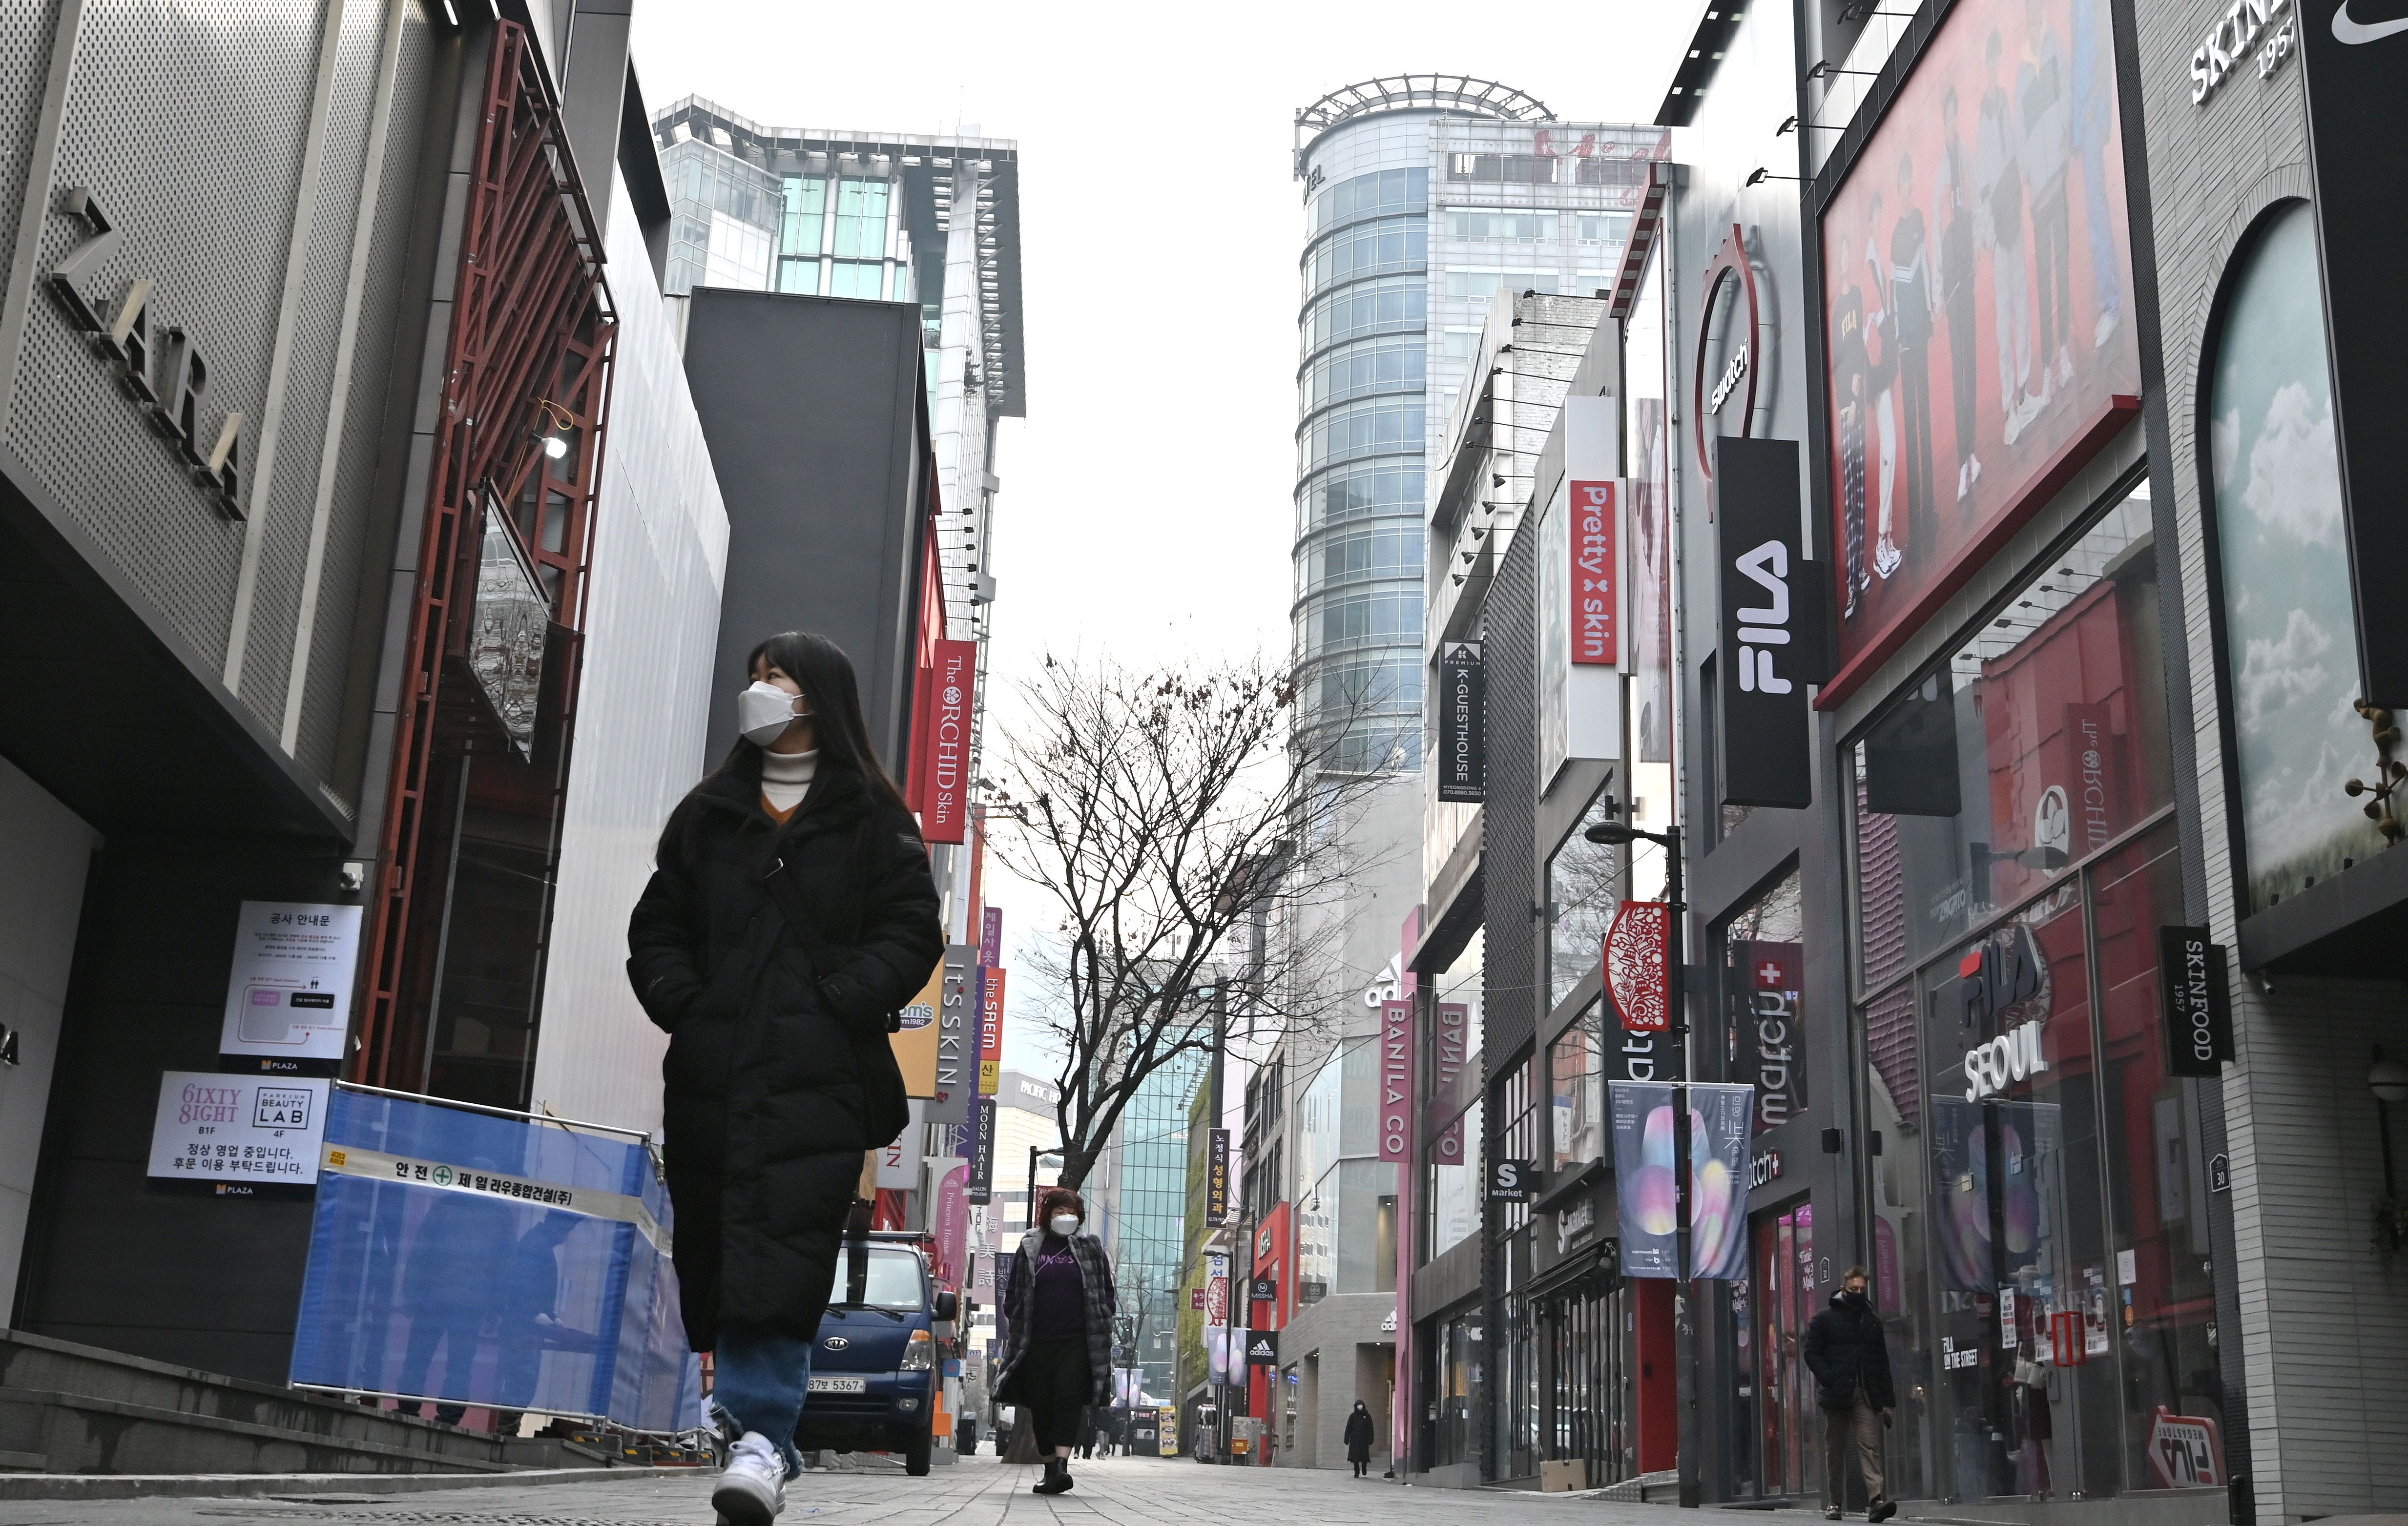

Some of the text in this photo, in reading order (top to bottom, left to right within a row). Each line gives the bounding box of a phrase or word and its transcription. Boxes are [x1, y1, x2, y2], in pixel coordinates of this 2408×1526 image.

[1842, 309, 1857, 340] FILA
[52, 186, 247, 521] ZARA
[1711, 338, 1748, 415] swatch
[1578, 487, 1610, 656] Pretty skin
[1736, 540, 1792, 694] FILA
[946, 656, 962, 683] The
[1456, 669, 1468, 781] K-GUESTHOUSE
[936, 792, 953, 824] Skin
[271, 913, 330, 926] 공사 안내문
[1959, 924, 2044, 1028] FILA
[2174, 984, 2185, 1012] 1957
[2185, 940, 2212, 1061] SKINFOOD
[982, 978, 998, 1049] the SAEM
[981, 1064, 993, 1076] 산
[1965, 1020, 2049, 1103] SEOUL
[183, 1083, 242, 1105] 6IXTY
[1386, 1008, 1405, 1154] BANILA CO
[179, 1104, 239, 1124] 8IGHT
[260, 1109, 303, 1123] LAB
[262, 1099, 304, 1108] BEAUTY
[198, 1126, 216, 1135] B1F
[977, 1105, 989, 1180] MOON HAIR
[188, 1143, 293, 1159] 정상 영업 중입니다.
[1214, 1135, 1225, 1163] 노정식
[173, 1157, 303, 1174] 후문 이용 부탁드립니다.
[1497, 1164, 1517, 1187] S
[2217, 1170, 2225, 1186] 30
[228, 1186, 253, 1195] PLAZA
[1211, 1165, 1224, 1214] 성형외과
[1492, 1188, 1522, 1197] Market
[943, 1192, 954, 1254] Princess House
[1942, 1336, 1953, 1353] FILA
[1951, 1351, 1960, 1368] THE
[1960, 1349, 1977, 1367] STREET
[809, 1380, 859, 1391] 87보 5367
[2156, 1426, 2204, 1441] MEGASTORE
[2159, 1438, 2213, 1484] FILA
